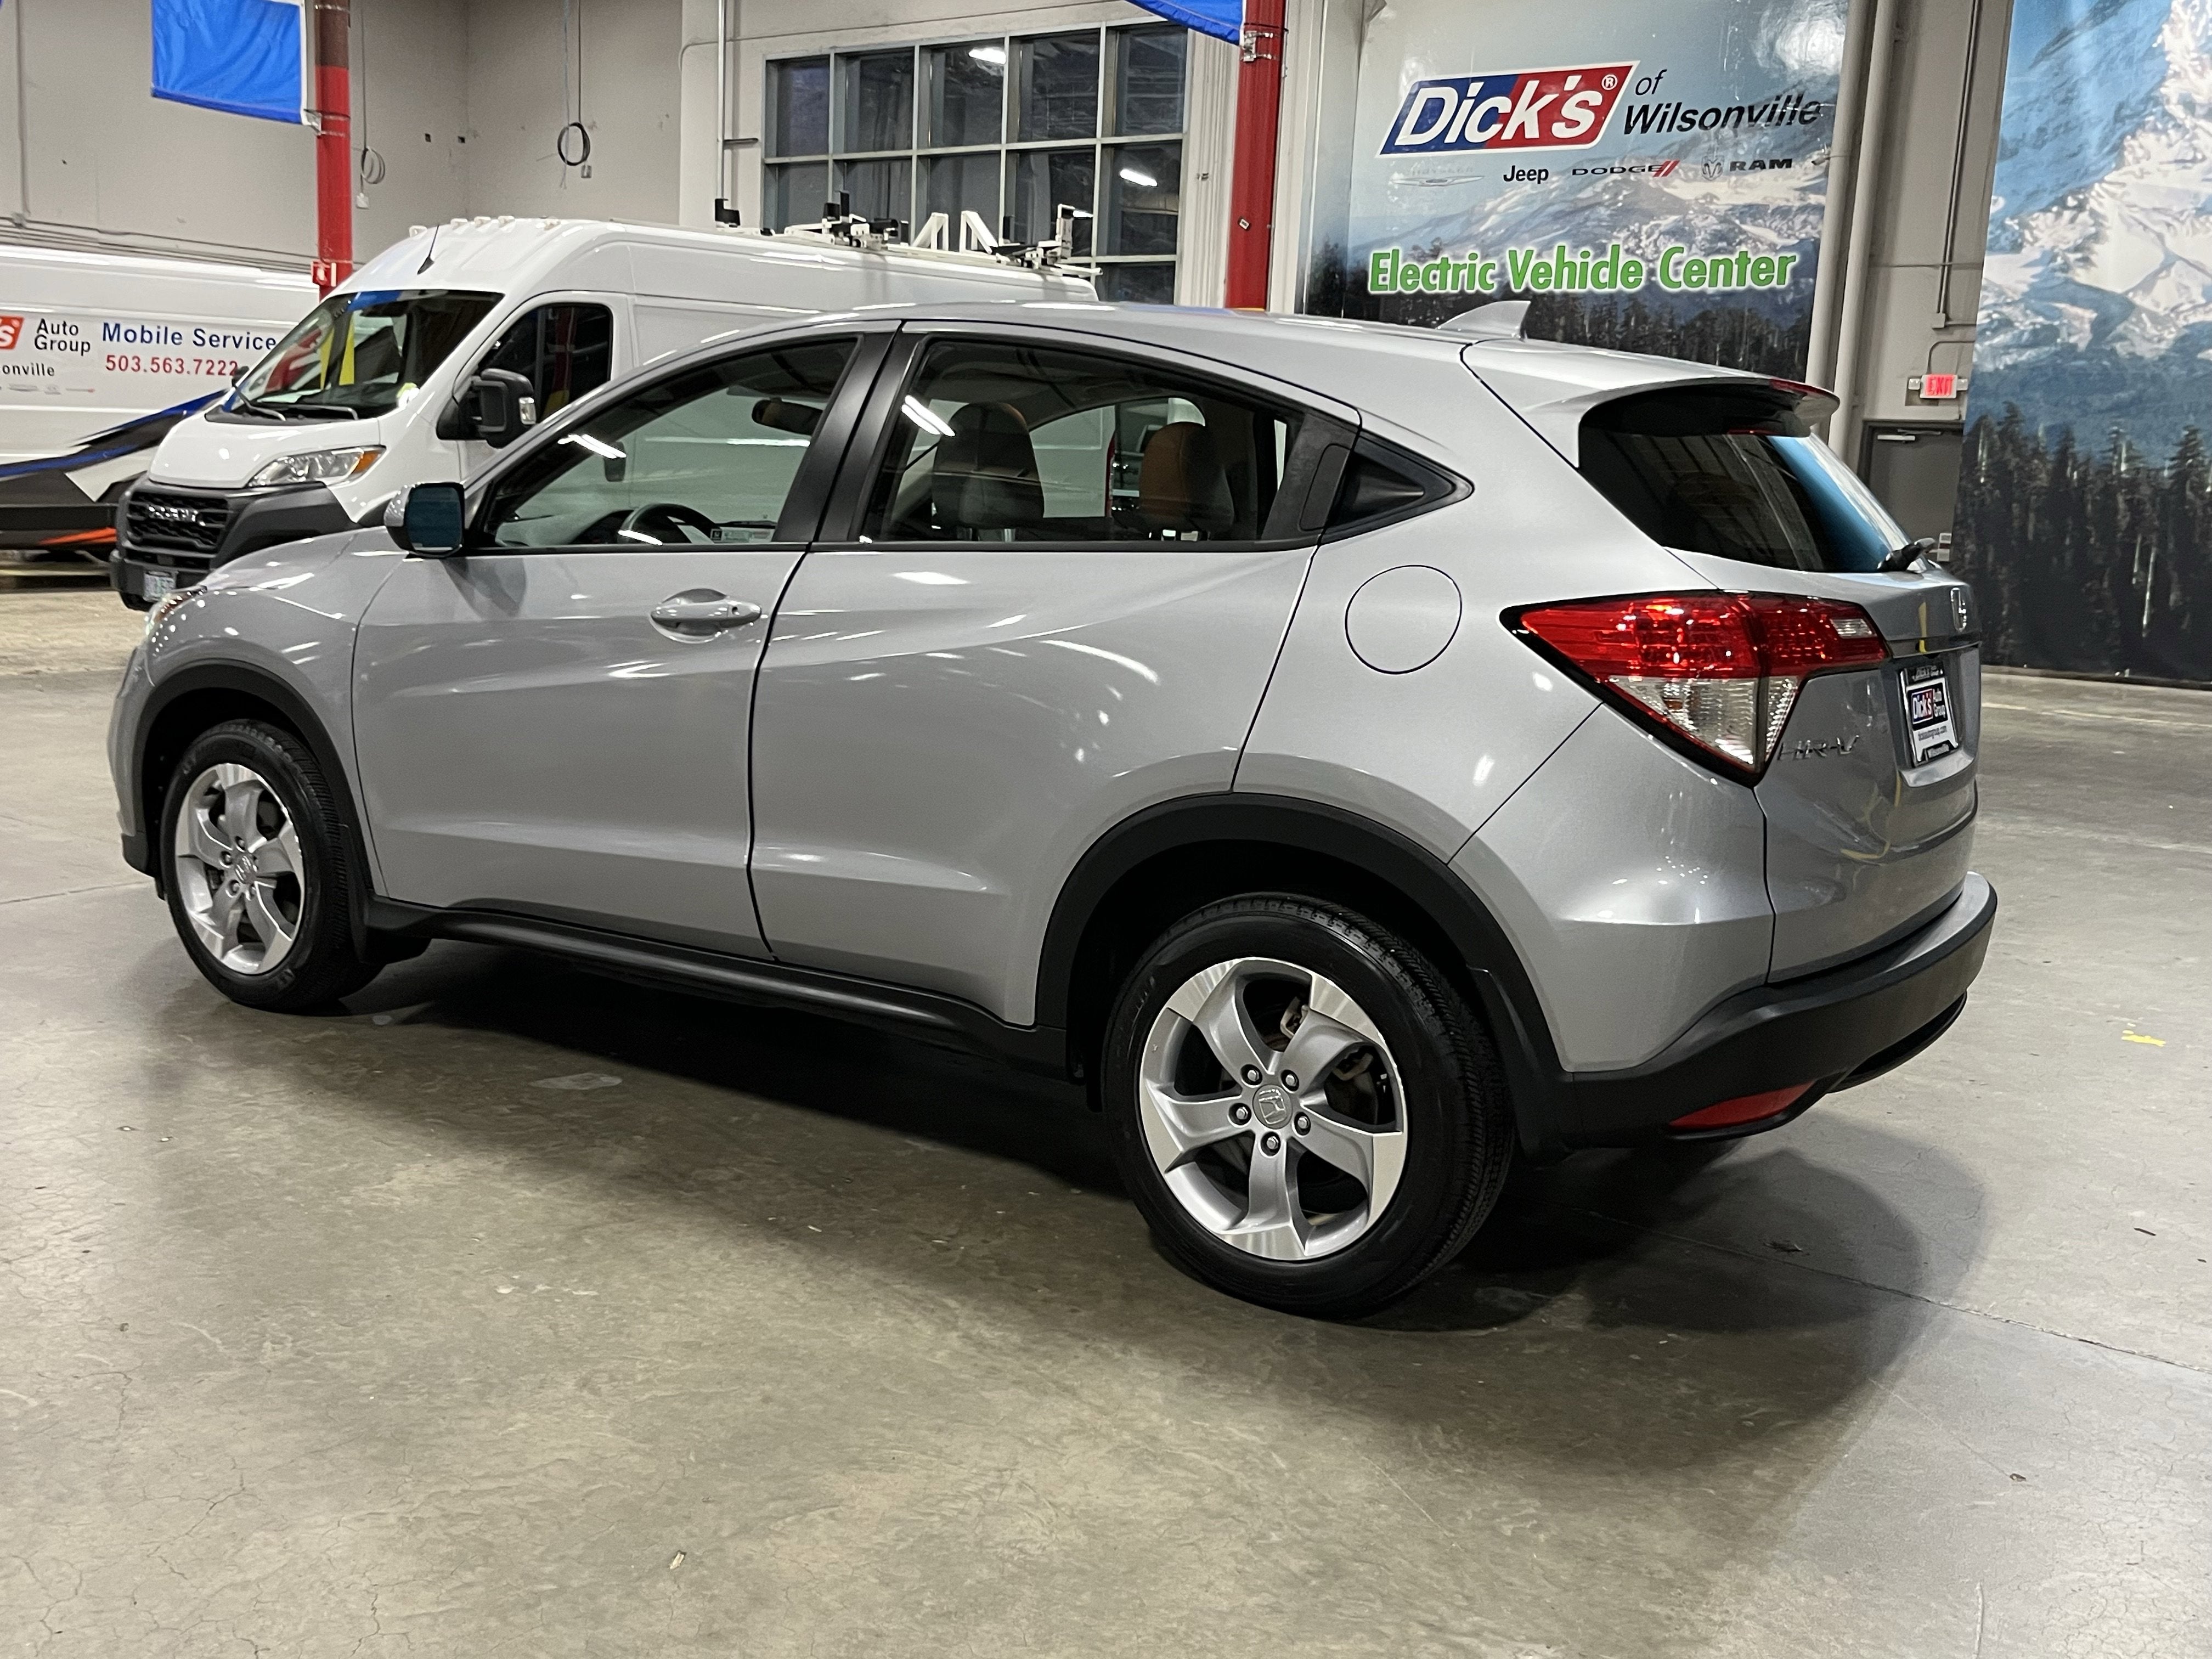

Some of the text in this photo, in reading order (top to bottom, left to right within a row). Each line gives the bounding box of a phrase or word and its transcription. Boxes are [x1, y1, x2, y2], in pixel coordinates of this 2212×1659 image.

[1635, 69, 1667, 95] of
[1624, 92, 1822, 135] Wilsonville
[1503, 165, 1549, 184] Jeep
[1572, 165, 1664, 176] DODGE
[1730, 159, 1792, 171] RAM
[1370, 244, 1797, 291] Electric Vehicle Center
[36, 318, 79, 336] Auto
[103, 322, 276, 349] Mobile Service
[34, 334, 91, 357] Group
[105, 354, 238, 376] 503.563.7222
[1927, 376, 1953, 395] EXIT
